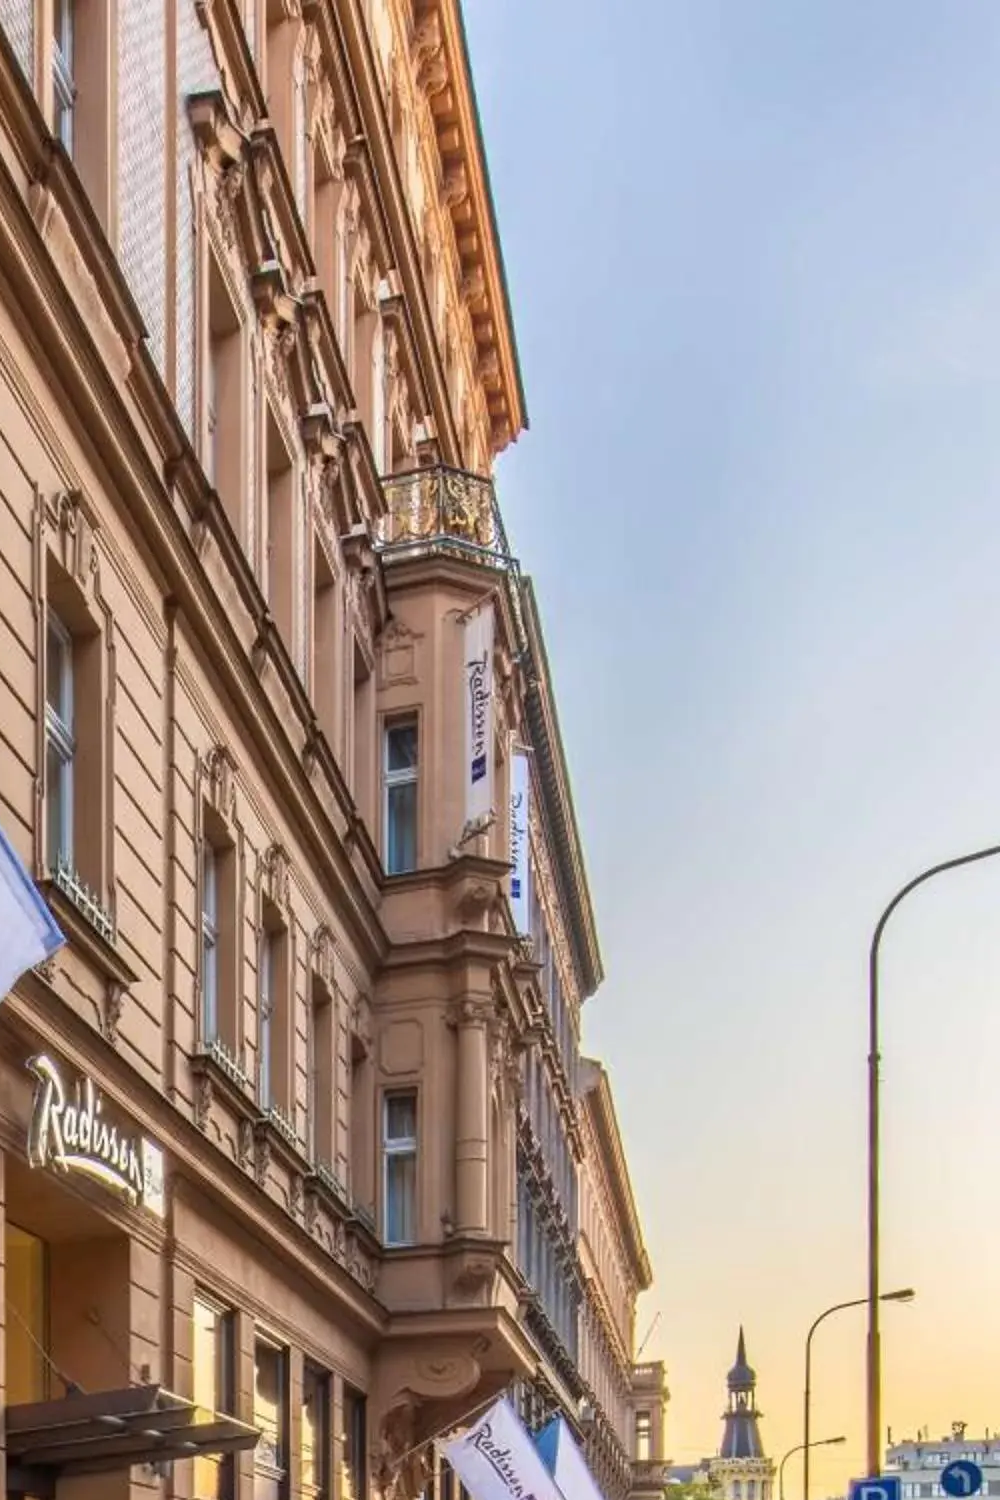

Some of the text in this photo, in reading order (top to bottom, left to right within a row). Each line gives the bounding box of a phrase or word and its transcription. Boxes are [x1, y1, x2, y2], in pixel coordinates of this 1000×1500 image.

[467, 650, 491, 756] Radisson
[25, 1055, 145, 1206] Radisson
[465, 1422, 524, 1499] Radisson
